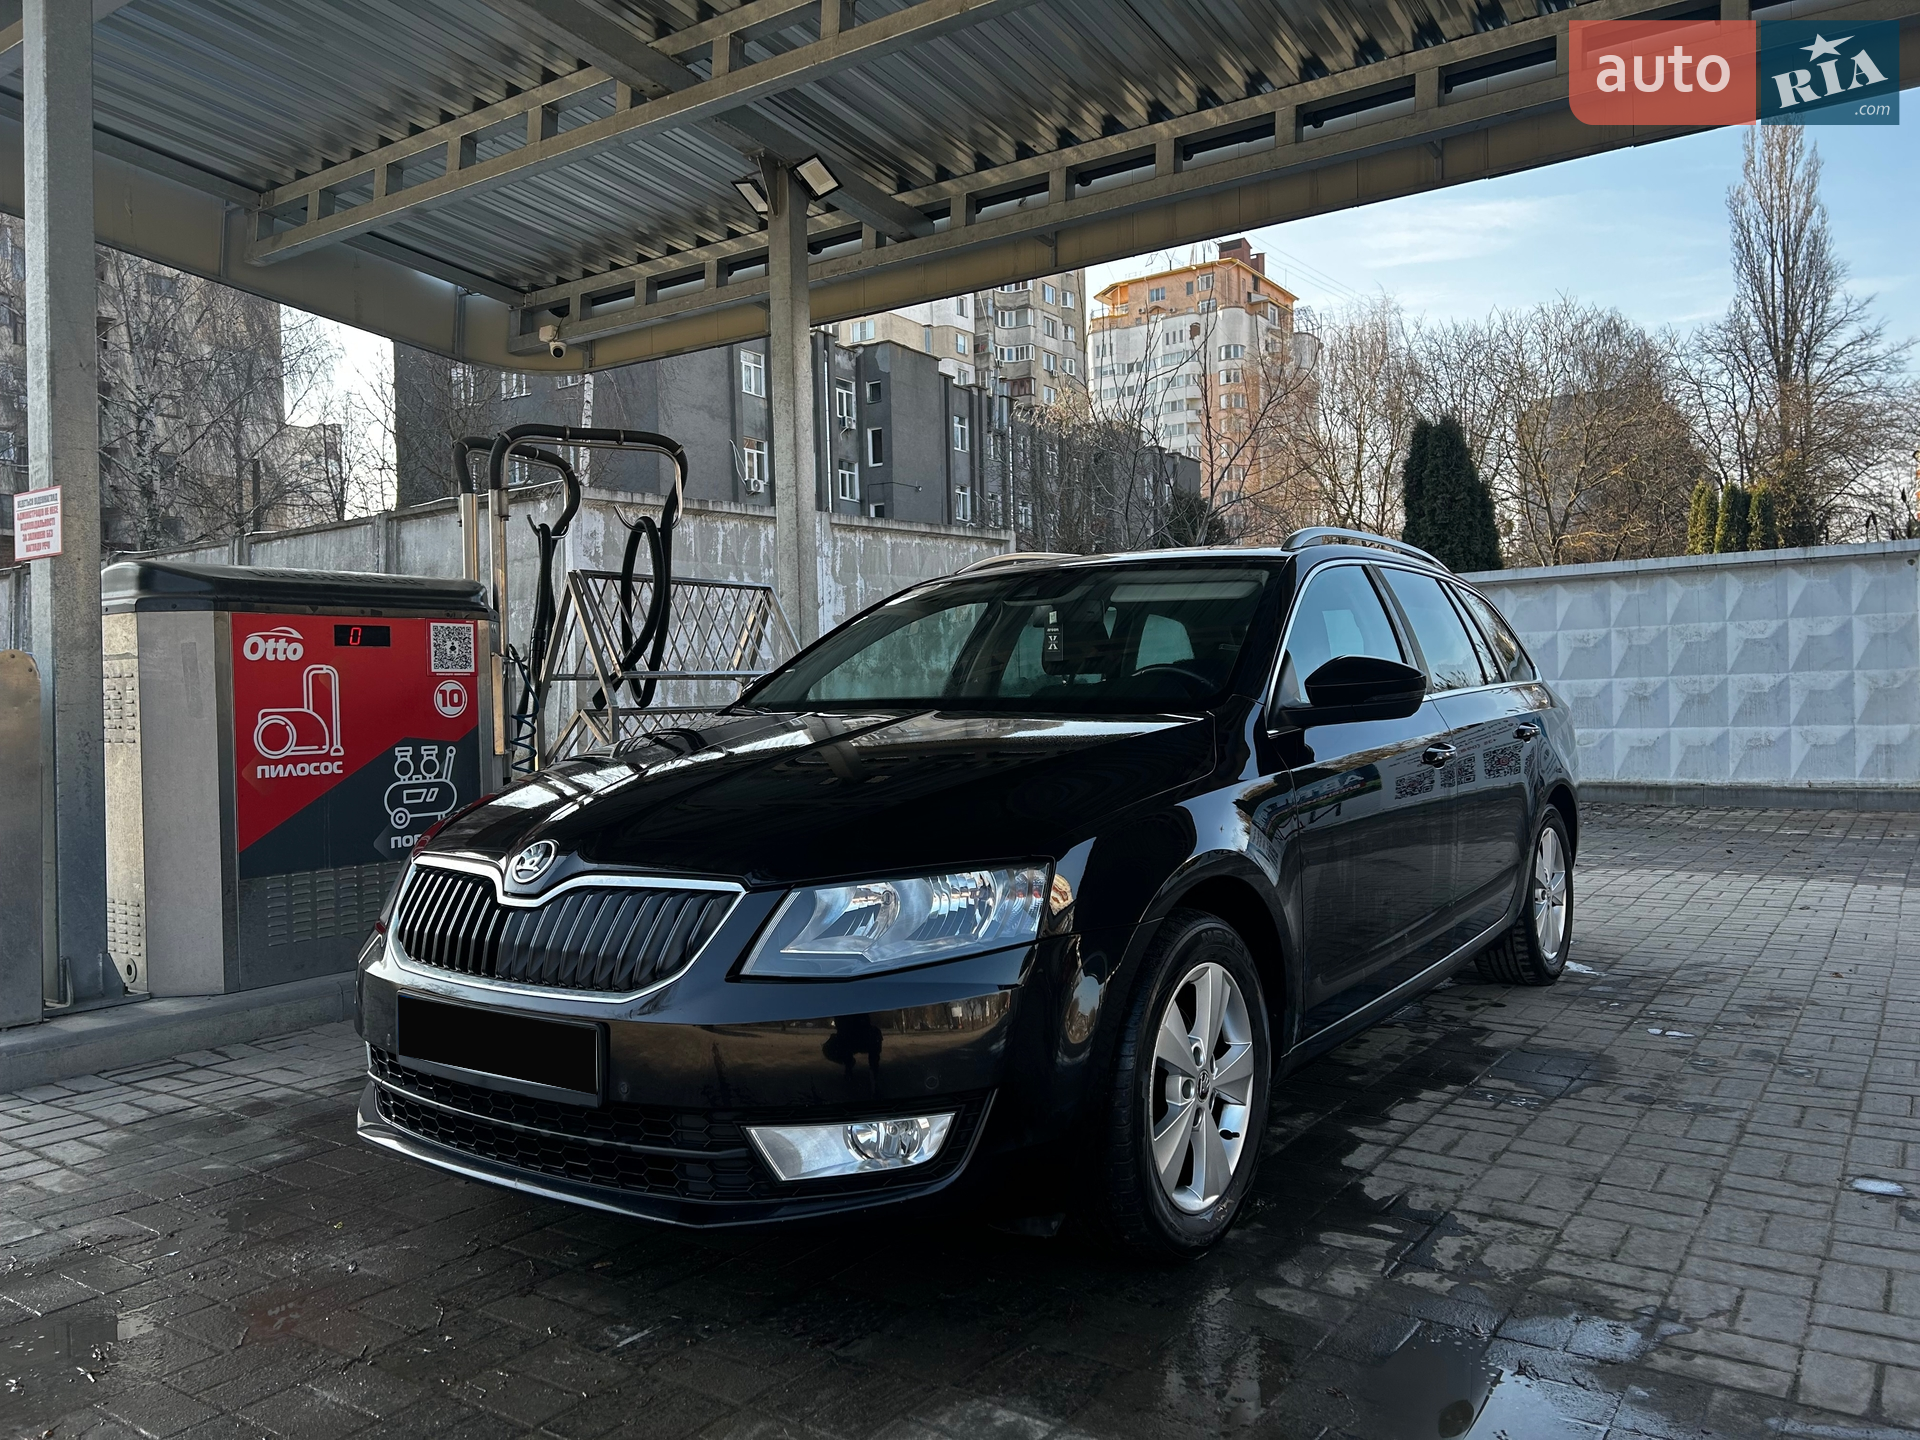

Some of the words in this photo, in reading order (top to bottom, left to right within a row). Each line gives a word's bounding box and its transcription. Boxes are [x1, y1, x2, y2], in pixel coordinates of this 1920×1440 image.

[349, 627, 362, 646] 0
[242, 634, 304, 662] Otto
[438, 688, 465, 708] 10
[256, 761, 344, 779] ПИЛОСОС
